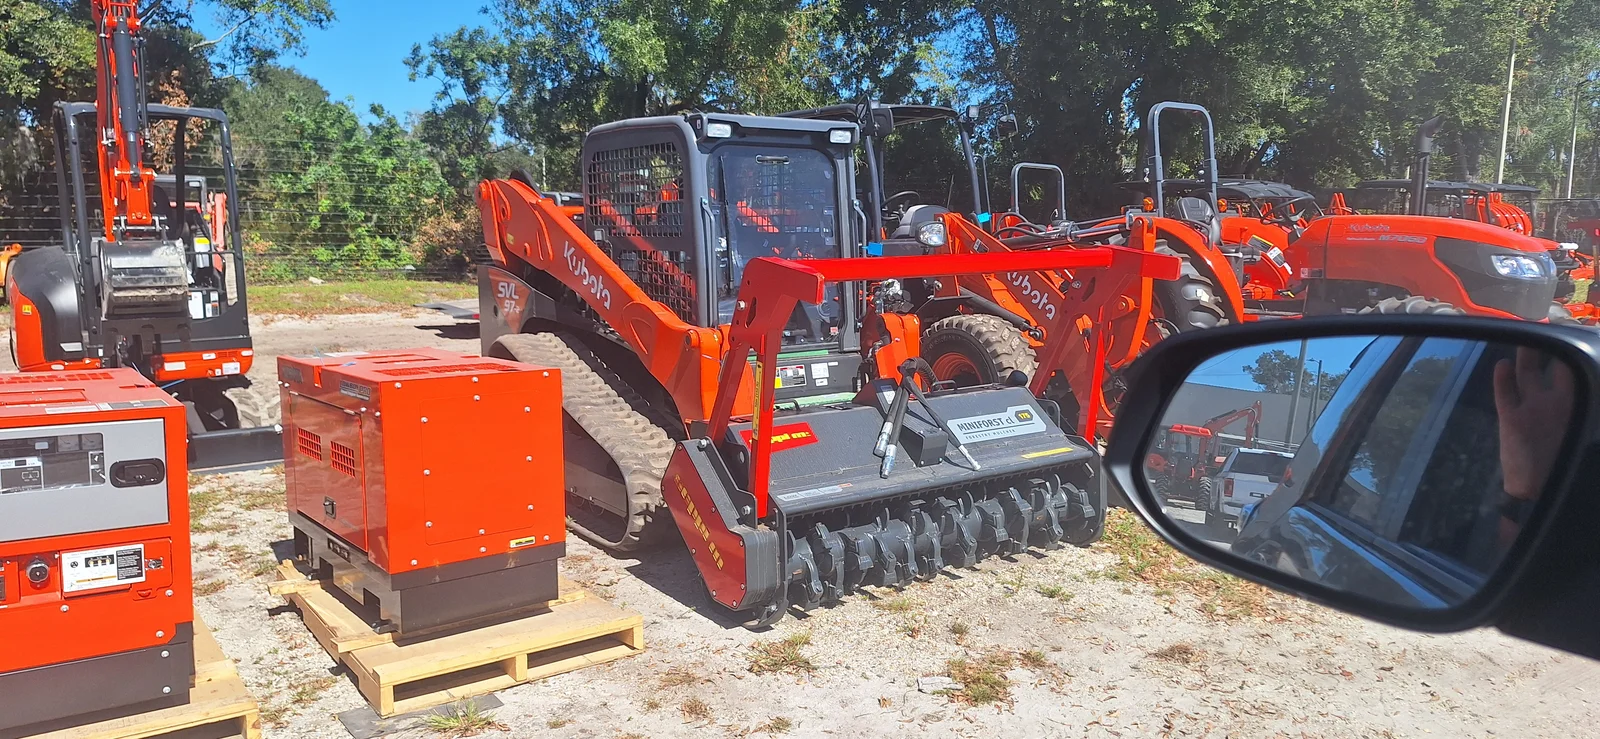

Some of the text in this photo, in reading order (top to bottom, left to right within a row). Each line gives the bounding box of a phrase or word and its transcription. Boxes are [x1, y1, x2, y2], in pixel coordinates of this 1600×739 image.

[1350, 223, 1390, 232] Kubota
[564, 240, 611, 310] Kubota
[497, 282, 520, 300] SVL
[957, 417, 1004, 431] MINIFORST
